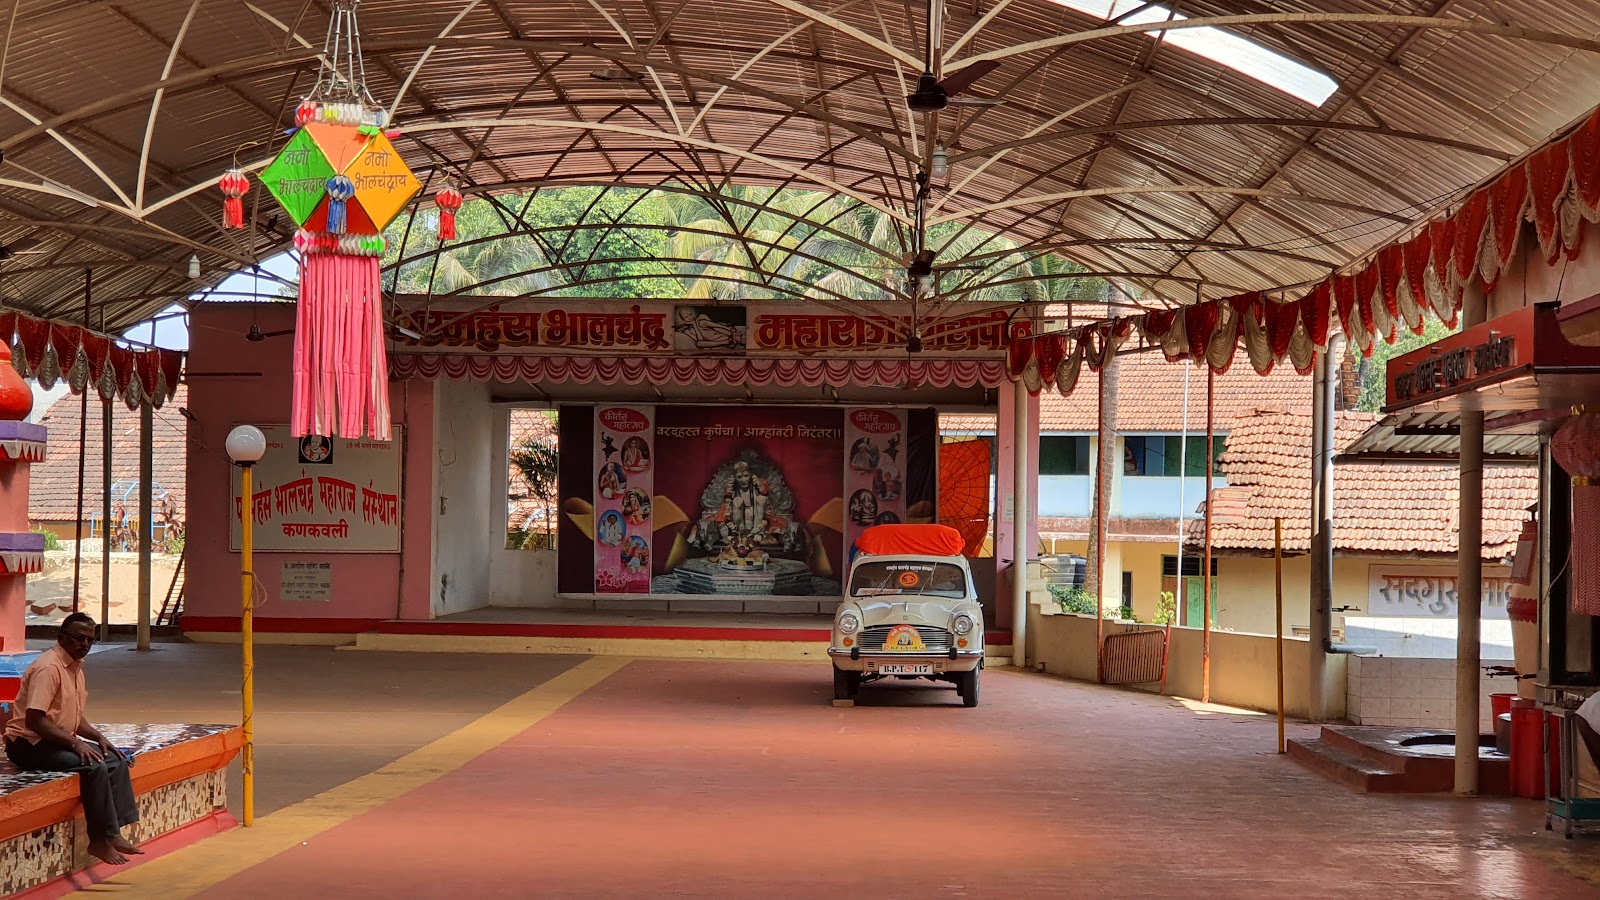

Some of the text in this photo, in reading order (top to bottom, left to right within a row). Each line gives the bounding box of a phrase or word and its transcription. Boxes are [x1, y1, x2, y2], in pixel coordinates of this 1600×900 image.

[284, 144, 311, 167] नमो
[364, 148, 392, 168] नमो
[354, 171, 408, 193] भालचंद्राय
[542, 305, 670, 350] भालचंद्र
[754, 313, 899, 352] महाराज
[604, 410, 628, 421] कीर्तन
[613, 420, 645, 430] महोत्सव
[856, 411, 880, 422] कीर्तन
[656, 426, 701, 438] वरदहस्त
[236, 468, 398, 526] पहंस भालचंद्र महाराज संस्थान
[282, 518, 349, 539] कणकवली
[914, 665, 928, 673] 117
